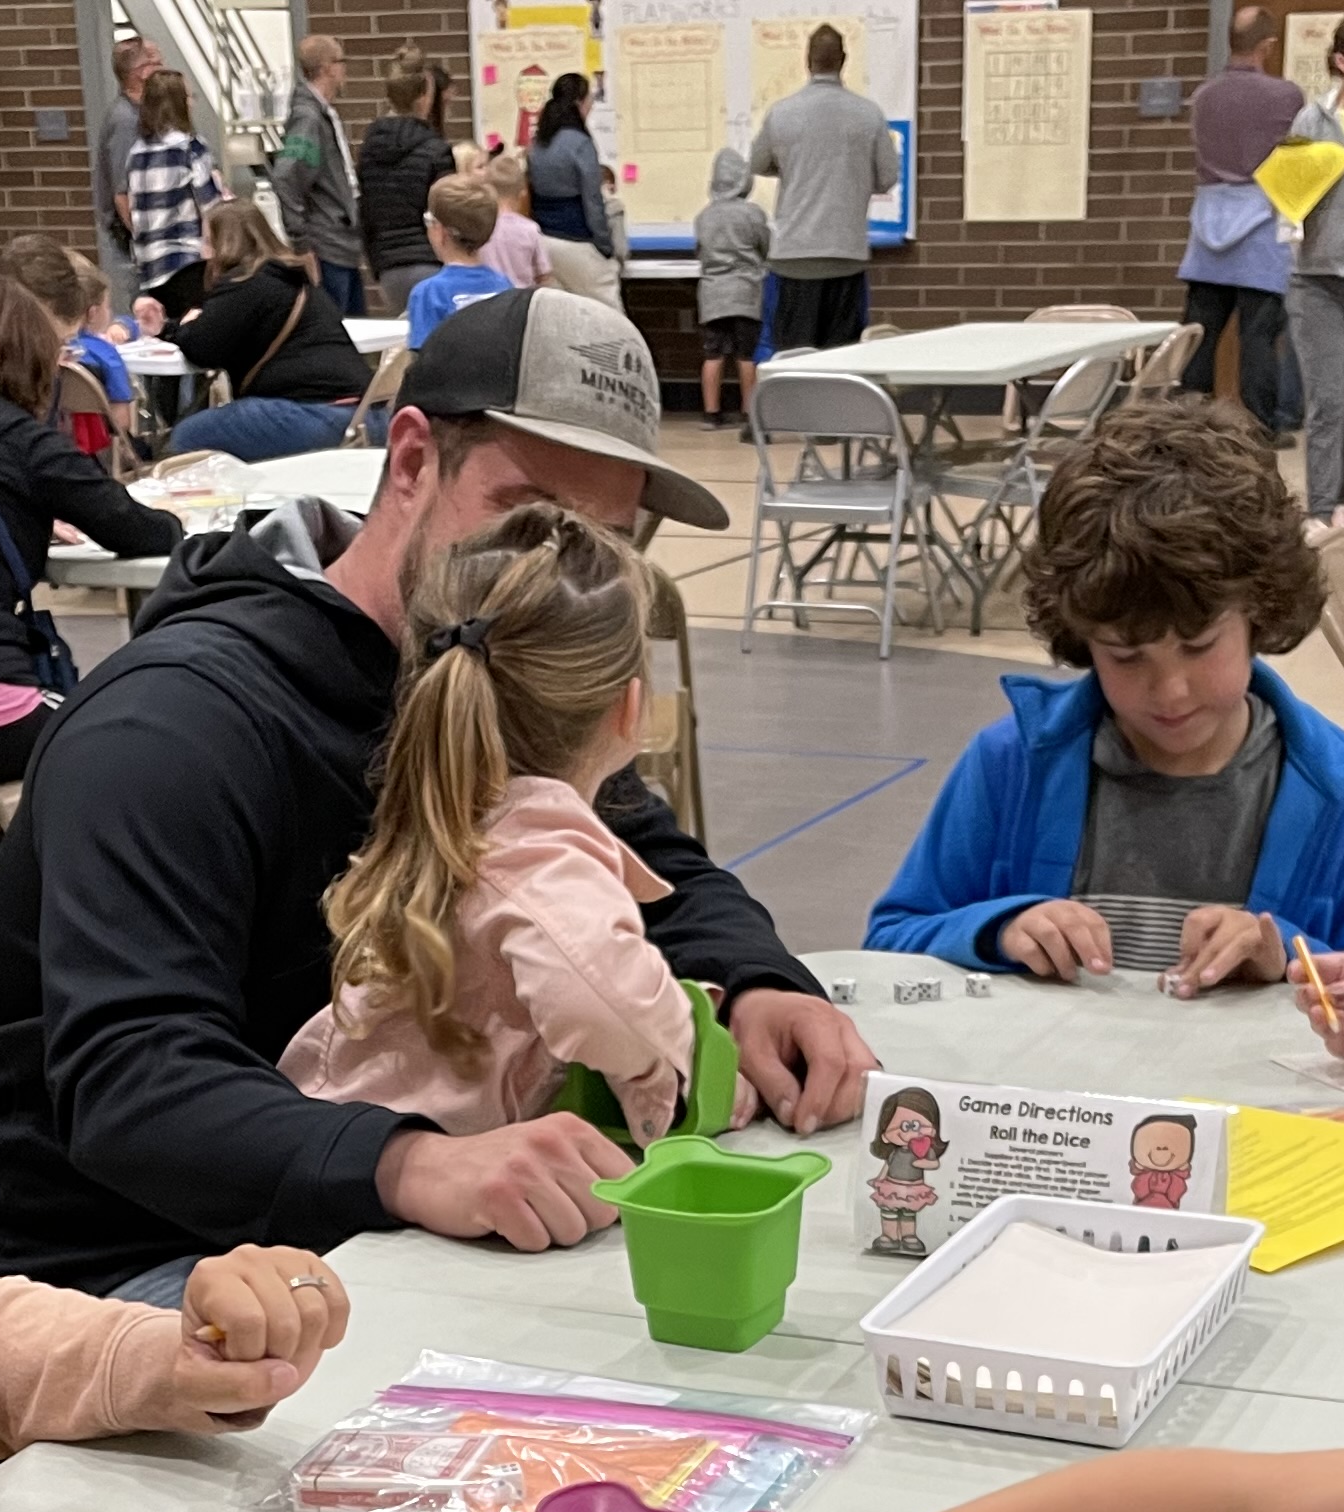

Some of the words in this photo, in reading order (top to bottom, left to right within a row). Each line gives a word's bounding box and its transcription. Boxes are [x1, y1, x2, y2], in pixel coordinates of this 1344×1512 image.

[958, 1095, 1012, 1116] Game
[1017, 1100, 1114, 1126] Directions
[989, 1125, 1018, 1142] Roll
[1022, 1128, 1049, 1145] the
[1052, 1131, 1091, 1149] Dice
